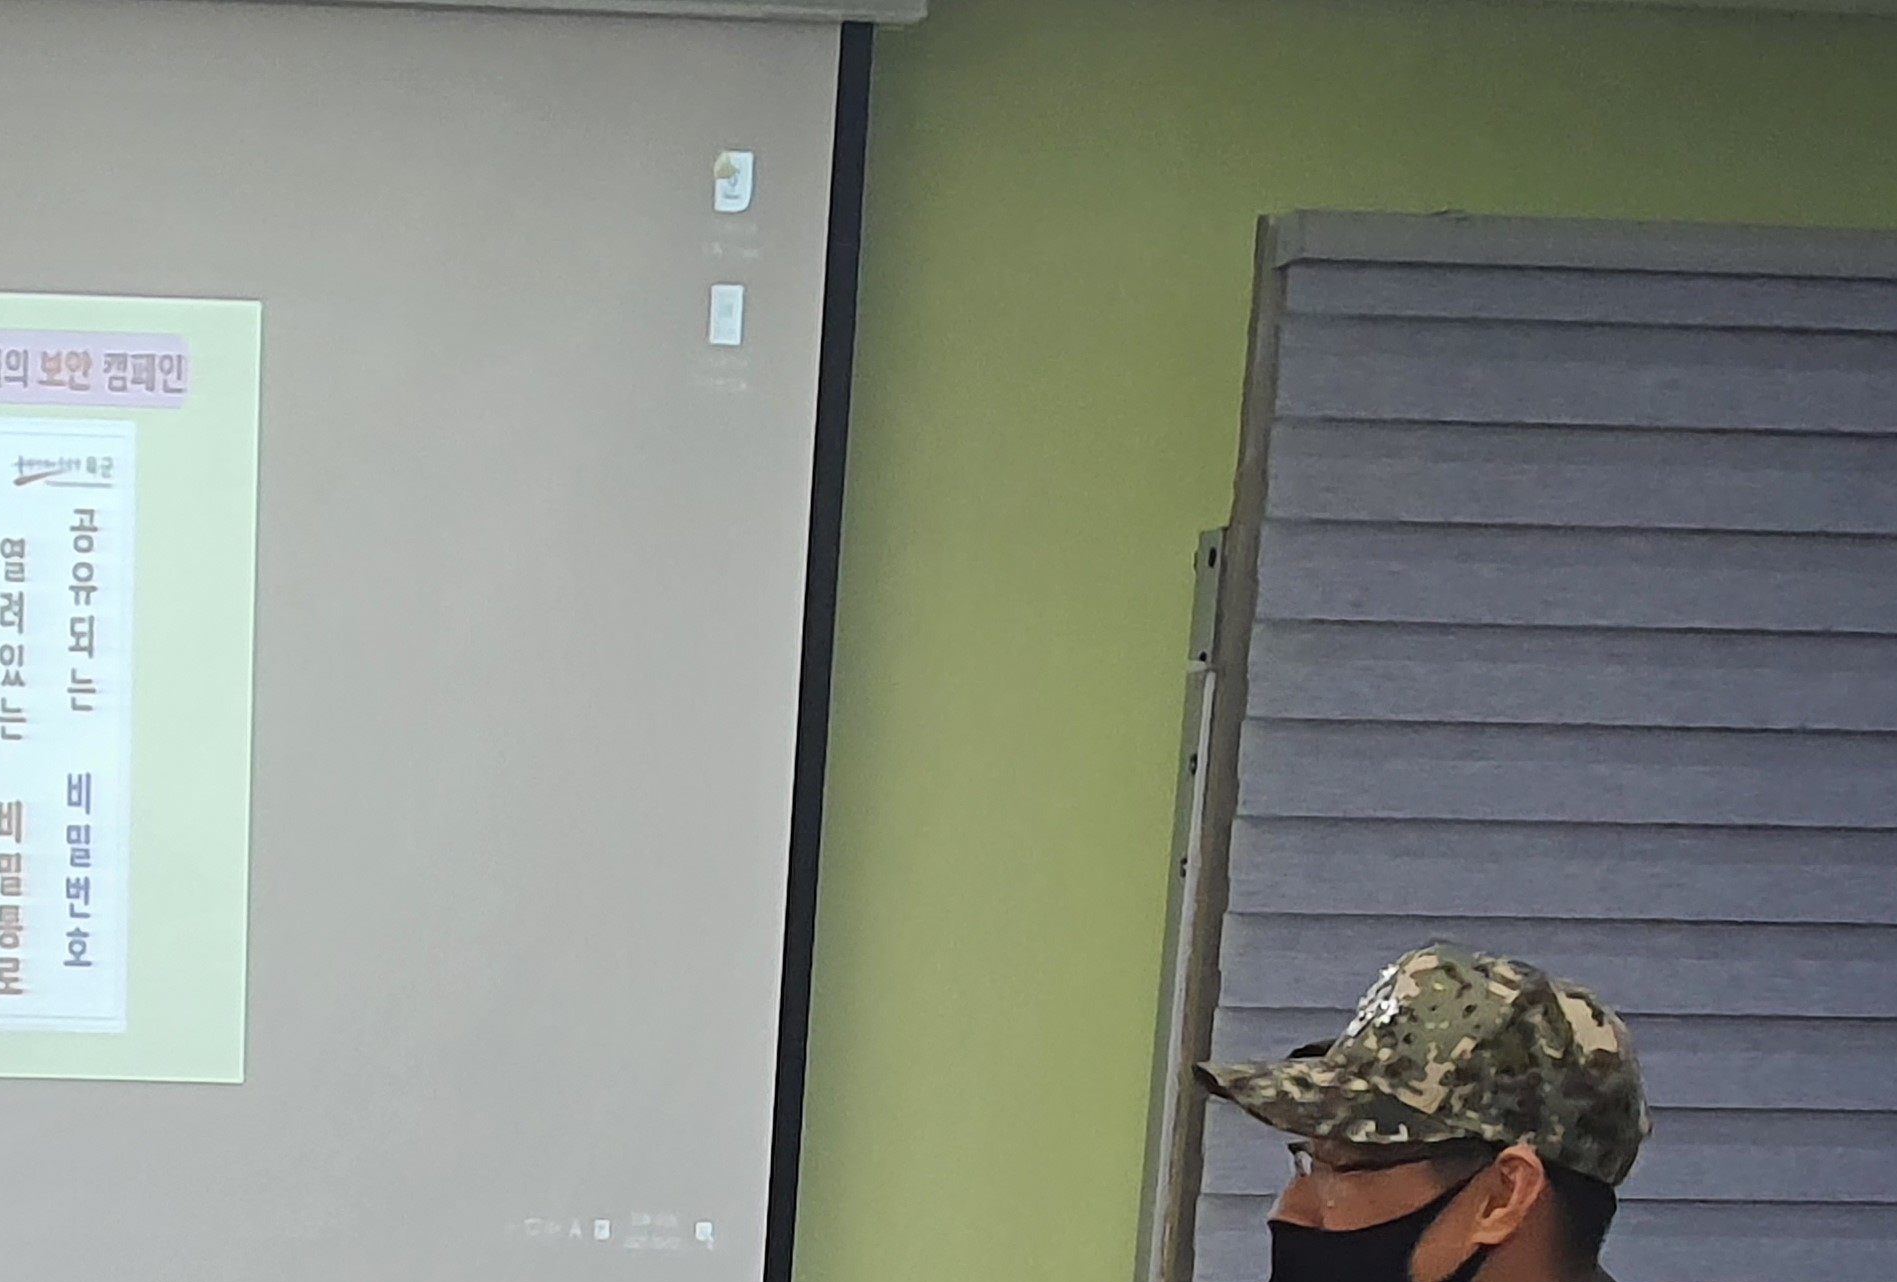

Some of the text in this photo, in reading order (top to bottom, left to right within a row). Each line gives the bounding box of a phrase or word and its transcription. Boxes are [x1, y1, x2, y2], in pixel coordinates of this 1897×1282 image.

[37, 350, 92, 391] 보안
[104, 353, 184, 393] 캠페인
[63, 508, 99, 967] 공유되는 비밀번호
